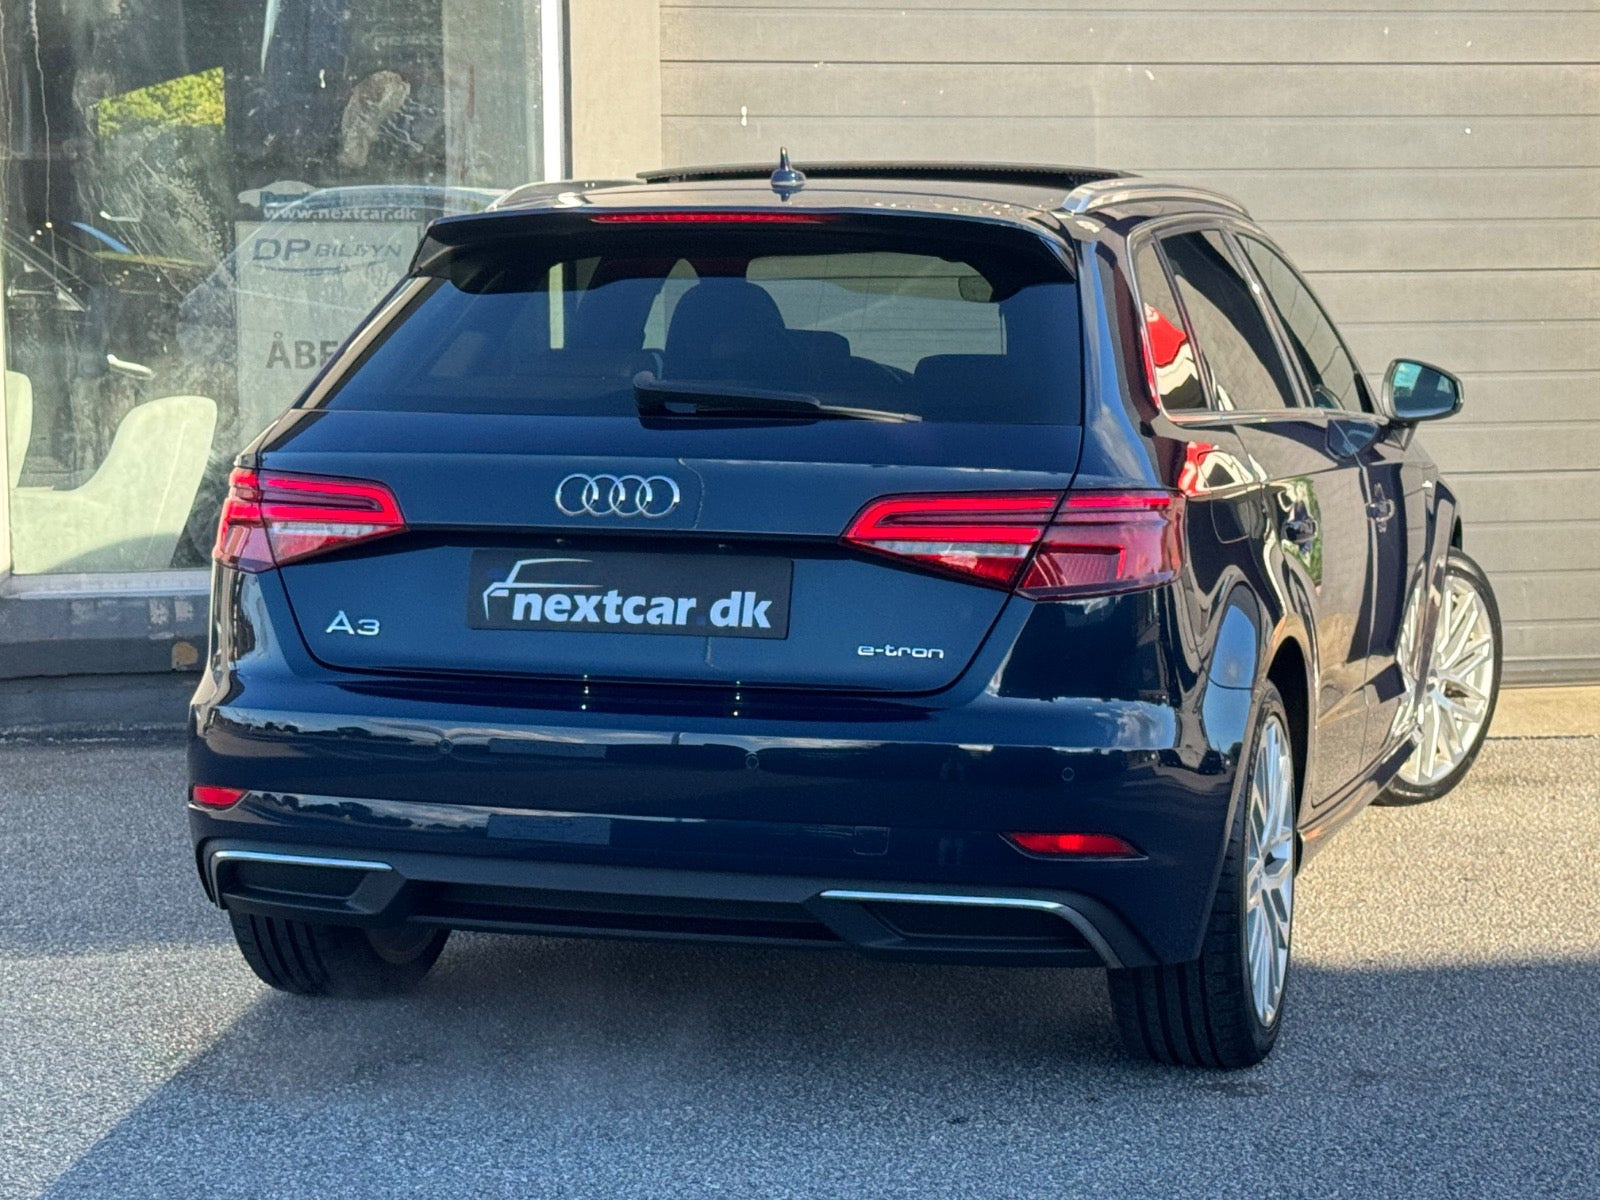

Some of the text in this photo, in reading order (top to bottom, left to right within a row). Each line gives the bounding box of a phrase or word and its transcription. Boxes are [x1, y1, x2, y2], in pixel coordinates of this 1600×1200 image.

[263, 206, 417, 220] www.nextcar.dk
[252, 238, 311, 260] DP
[325, 609, 380, 635] A3
[857, 644, 945, 659] e-tron
